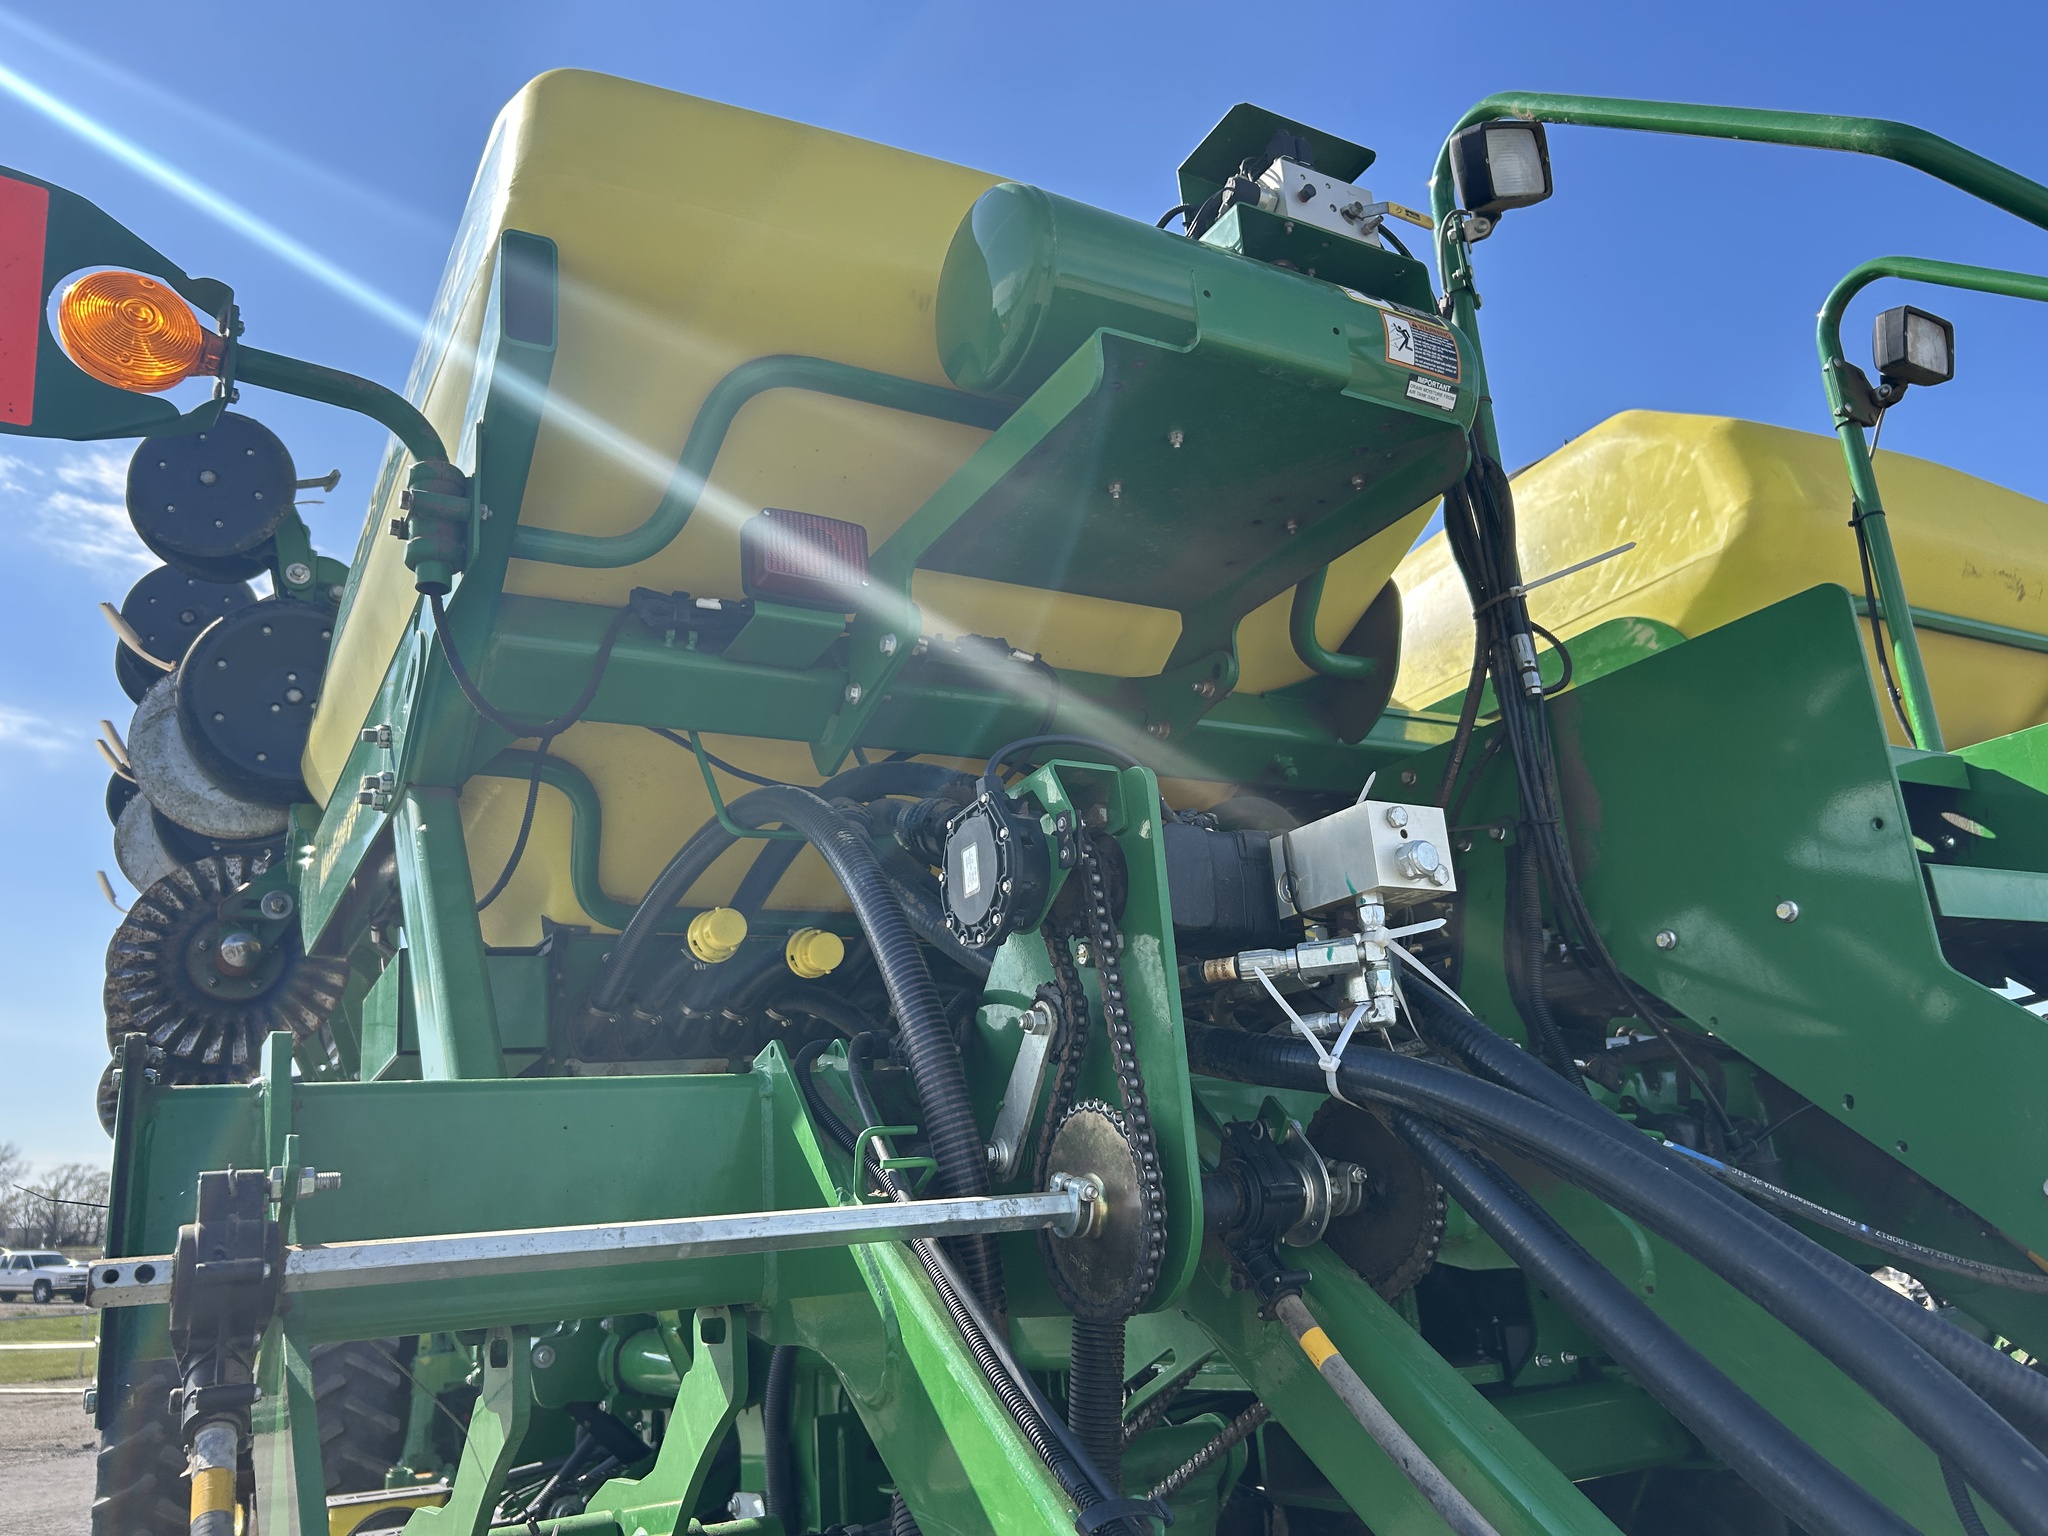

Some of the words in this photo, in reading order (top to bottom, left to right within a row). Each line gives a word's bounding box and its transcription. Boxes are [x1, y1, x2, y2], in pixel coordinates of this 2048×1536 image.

[1418, 324, 1452, 339] WARNING
[1417, 376, 1451, 392] IMPORTANT
[1410, 383, 1423, 391] DRAIN
[1423, 387, 1443, 398] MOISTURE
[1443, 393, 1455, 402] FROM
[1416, 391, 1427, 399] TANK
[1763, 1182, 1788, 1198] MSHA
[1789, 1193, 1829, 1216] Resistant
[1830, 1210, 1857, 1227] Flame
[1875, 1230, 1910, 1248] 100R17
